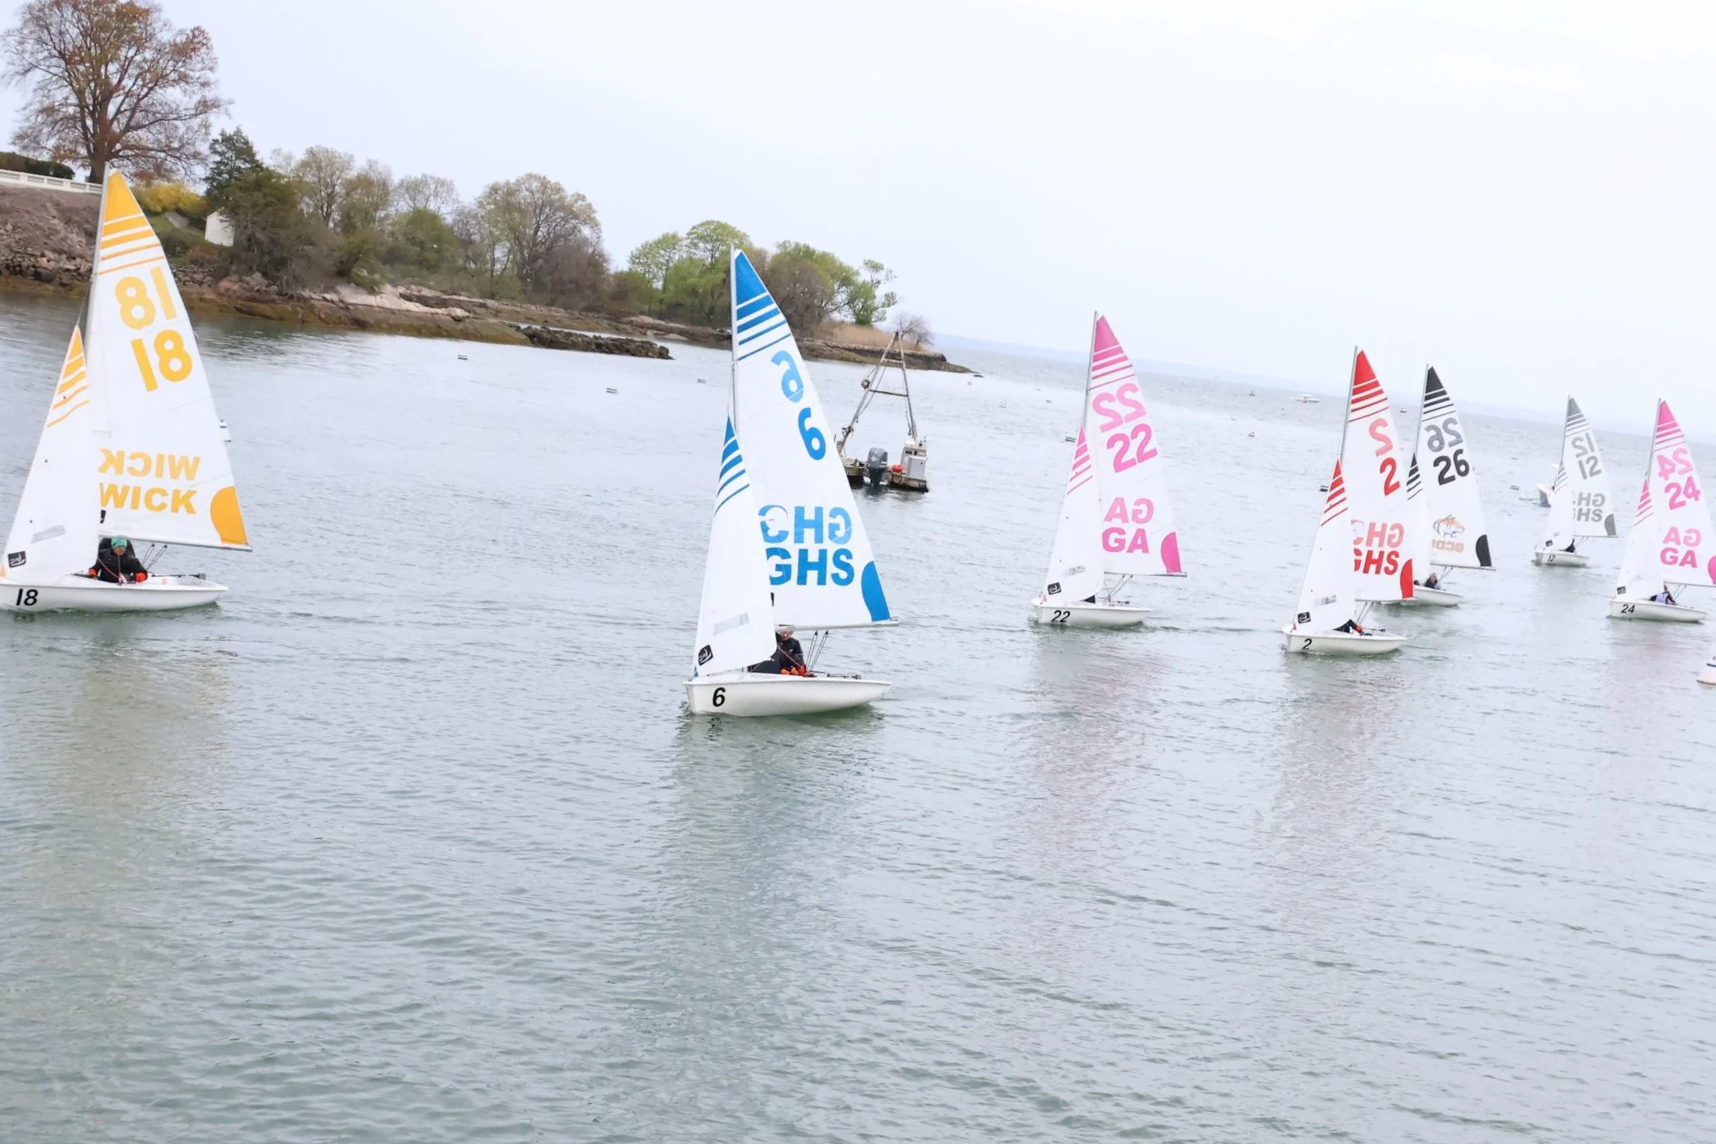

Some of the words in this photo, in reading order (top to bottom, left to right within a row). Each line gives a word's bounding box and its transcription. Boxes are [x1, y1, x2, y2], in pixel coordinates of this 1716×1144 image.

[131, 330, 192, 391] 18
[798, 407, 826, 460] 6
[1107, 424, 1158, 473] 22
[1380, 457, 1400, 496] 2
[1433, 449, 1469, 485] 26
[1578, 456, 1602, 480] 12
[100, 483, 196, 514] WICK
[1664, 476, 1701, 510] 24
[1573, 508, 1602, 522] HS
[1102, 527, 1149, 554] GA
[766, 547, 854, 586] GHS
[1660, 547, 1697, 568] GA
[16, 589, 38, 606] 18
[1621, 604, 1635, 613] 24
[1051, 610, 1071, 623] 22
[1303, 638, 1312, 650] 2
[713, 687, 725, 707] 6
